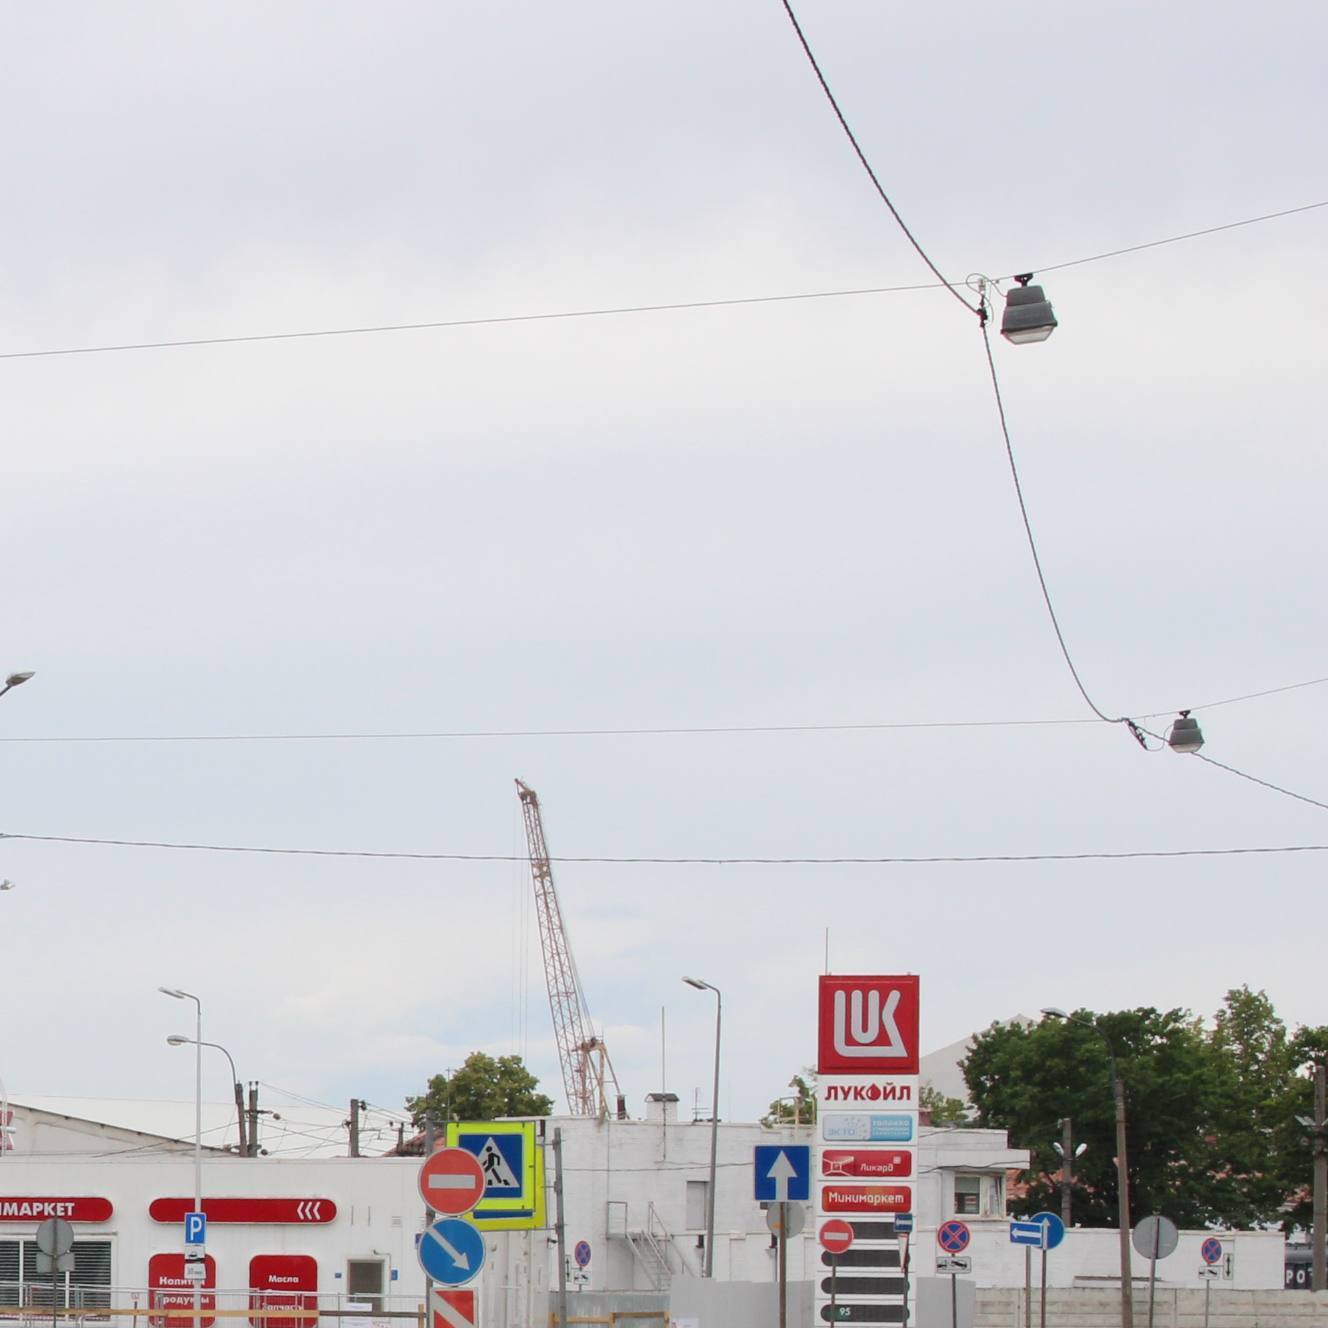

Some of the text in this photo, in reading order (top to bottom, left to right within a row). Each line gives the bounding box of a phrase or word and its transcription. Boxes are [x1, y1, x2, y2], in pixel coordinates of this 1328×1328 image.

[825, 1082, 911, 1101] ЛУКОЙЛ
[828, 1191, 905, 1206] Минимаркет
[159, 1276, 206, 1286] Напити
[268, 1274, 300, 1283] Масла
[160, 1296, 210, 1305] родуы
[839, 1307, 851, 1316] 95
